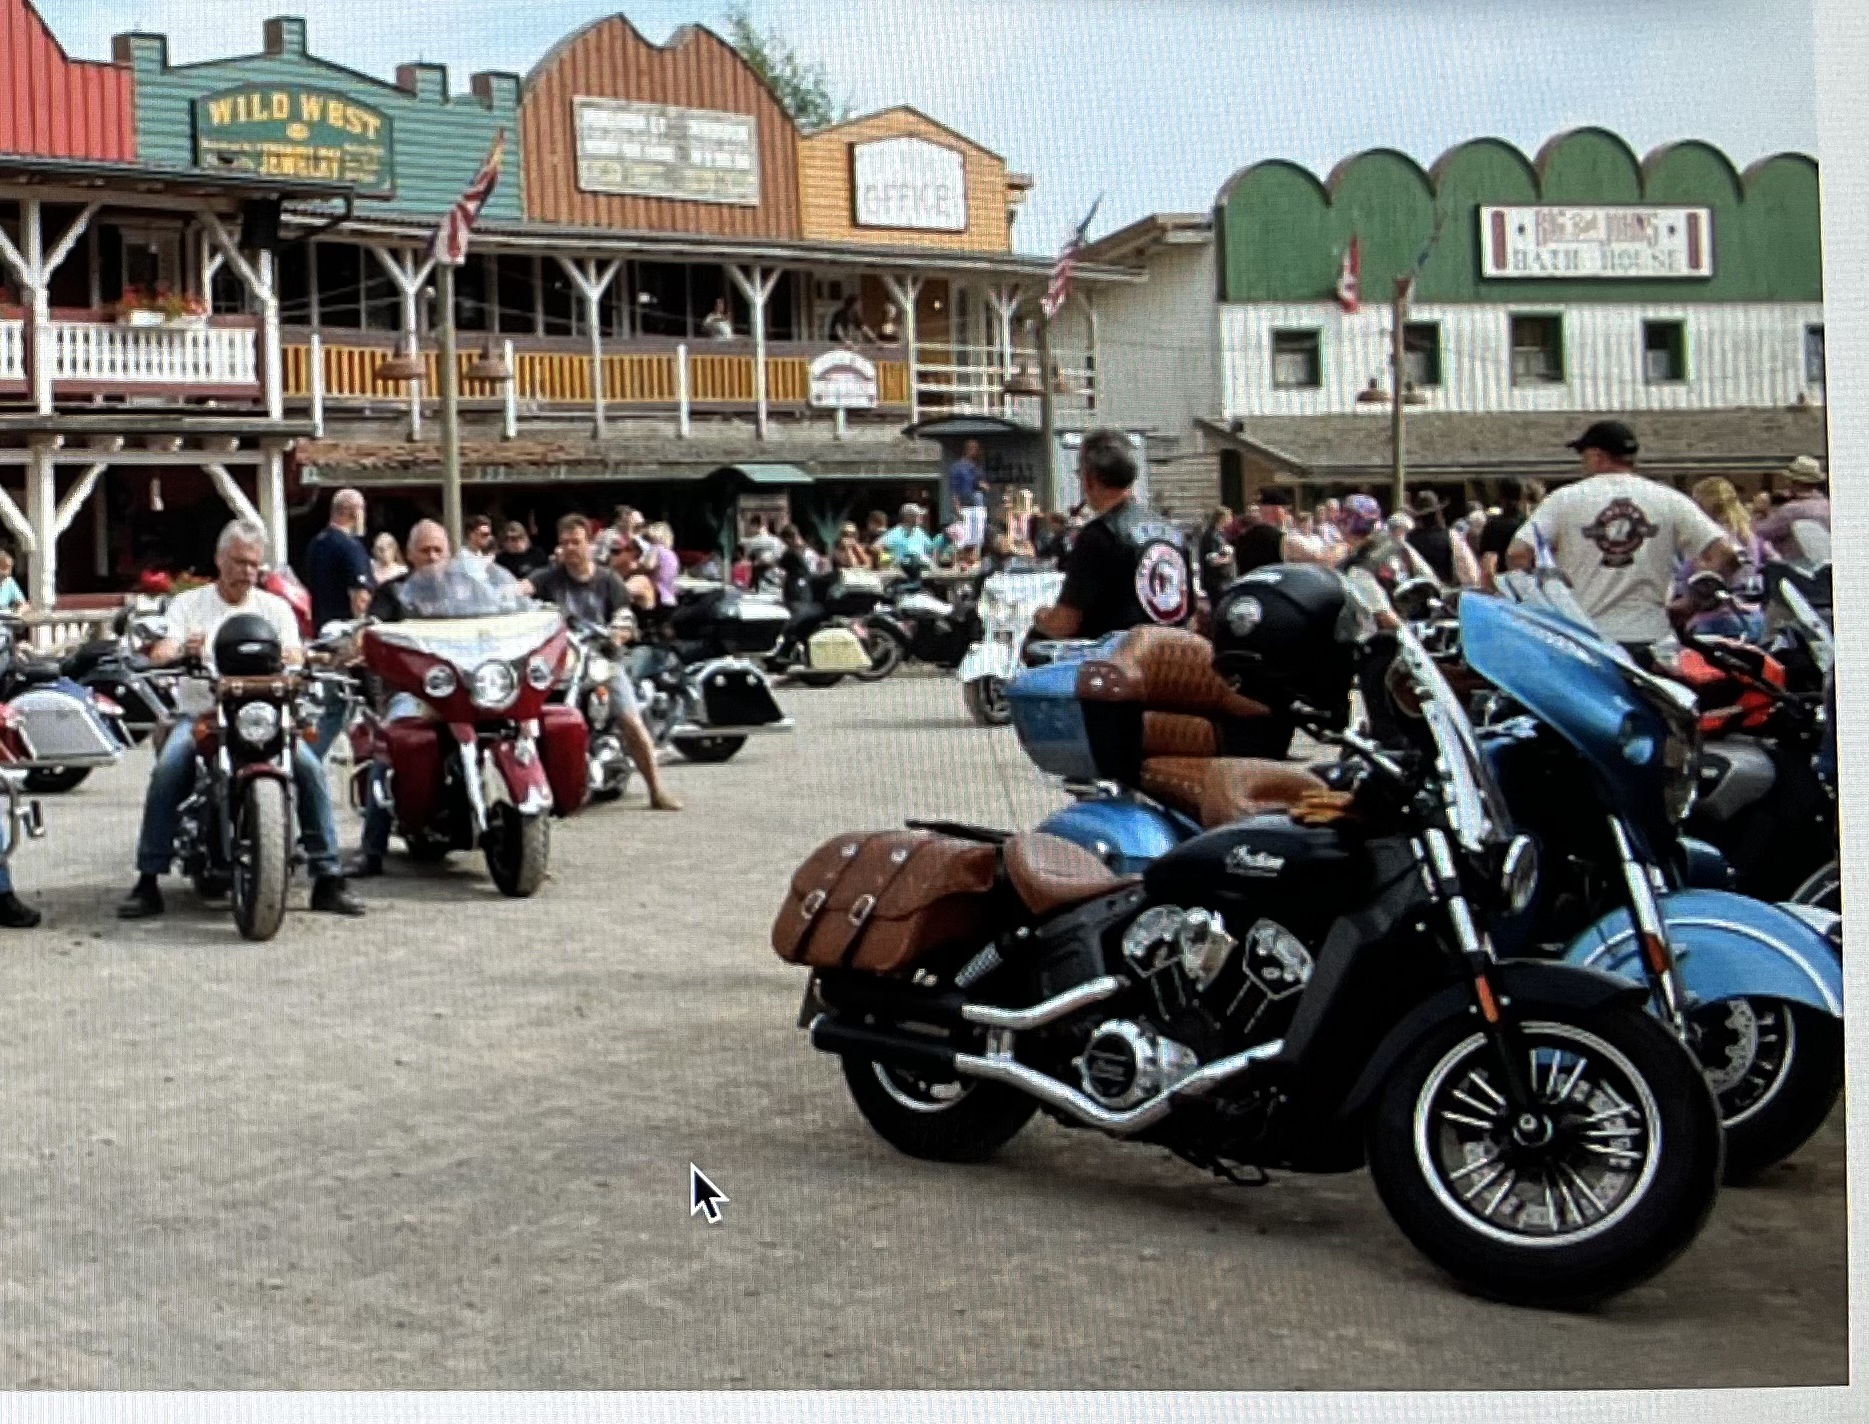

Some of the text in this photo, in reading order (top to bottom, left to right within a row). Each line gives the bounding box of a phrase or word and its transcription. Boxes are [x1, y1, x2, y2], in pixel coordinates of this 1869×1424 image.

[208, 92, 381, 140] WILD WEST
[1514, 249, 1683, 273] BATH HOUSE
